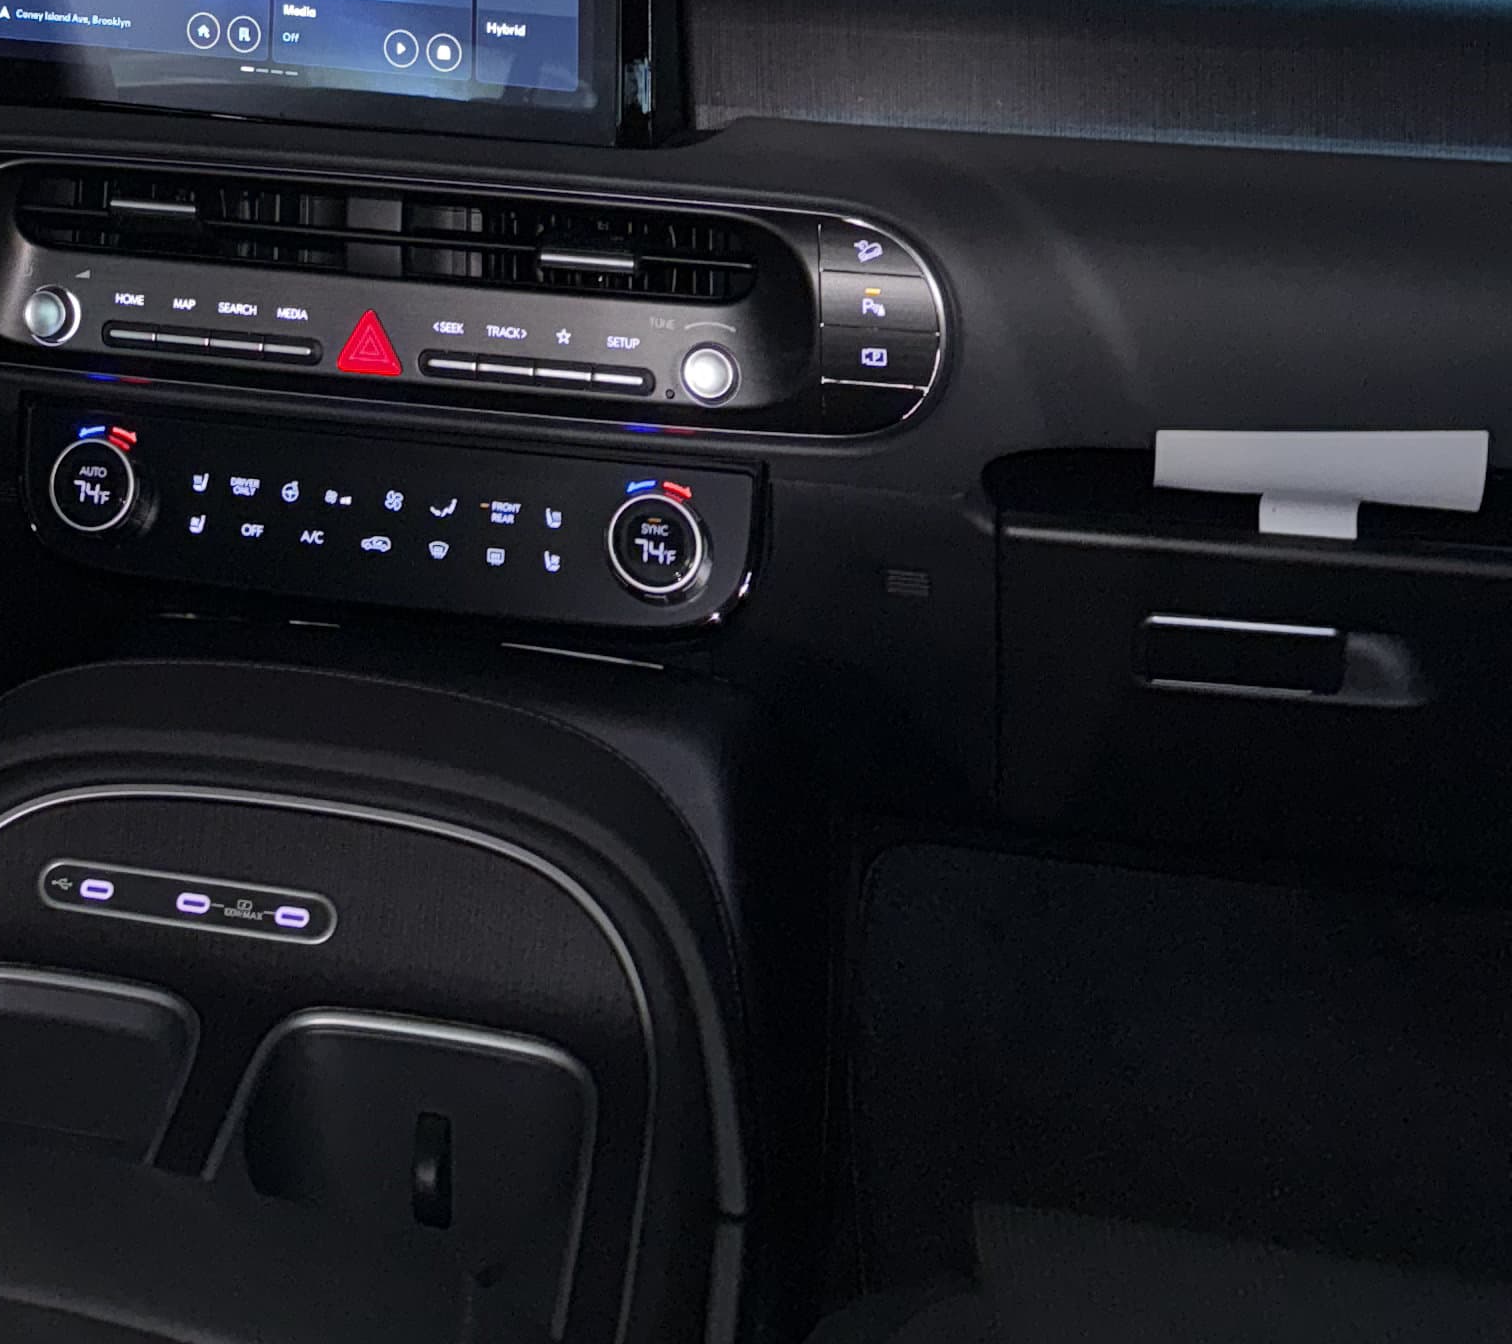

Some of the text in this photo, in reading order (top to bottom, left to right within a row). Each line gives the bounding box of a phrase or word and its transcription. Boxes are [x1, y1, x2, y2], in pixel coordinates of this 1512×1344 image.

[282, 3, 317, 18] Media
[15, 8, 44, 22] Coney
[44, 11, 73, 23] Island
[92, 16, 131, 29] Brooklyn
[486, 21, 527, 37] Hybrid
[282, 31, 300, 44] Off
[115, 292, 145, 306] HOME
[173, 298, 196, 310] MAP
[218, 301, 257, 316] SEARCH
[277, 307, 308, 321] MEDIA
[606, 336, 640, 350] SETUP
[649, 316, 675, 330] TUNE
[79, 466, 107, 478] AUTO
[230, 476, 260, 489] DRIVER
[233, 485, 257, 497] ONLY
[491, 500, 522, 514] FRONT
[491, 512, 515, 524] REAR
[241, 523, 264, 537] OFF
[641, 523, 669, 536] SYNC
[300, 529, 325, 545] A/C
